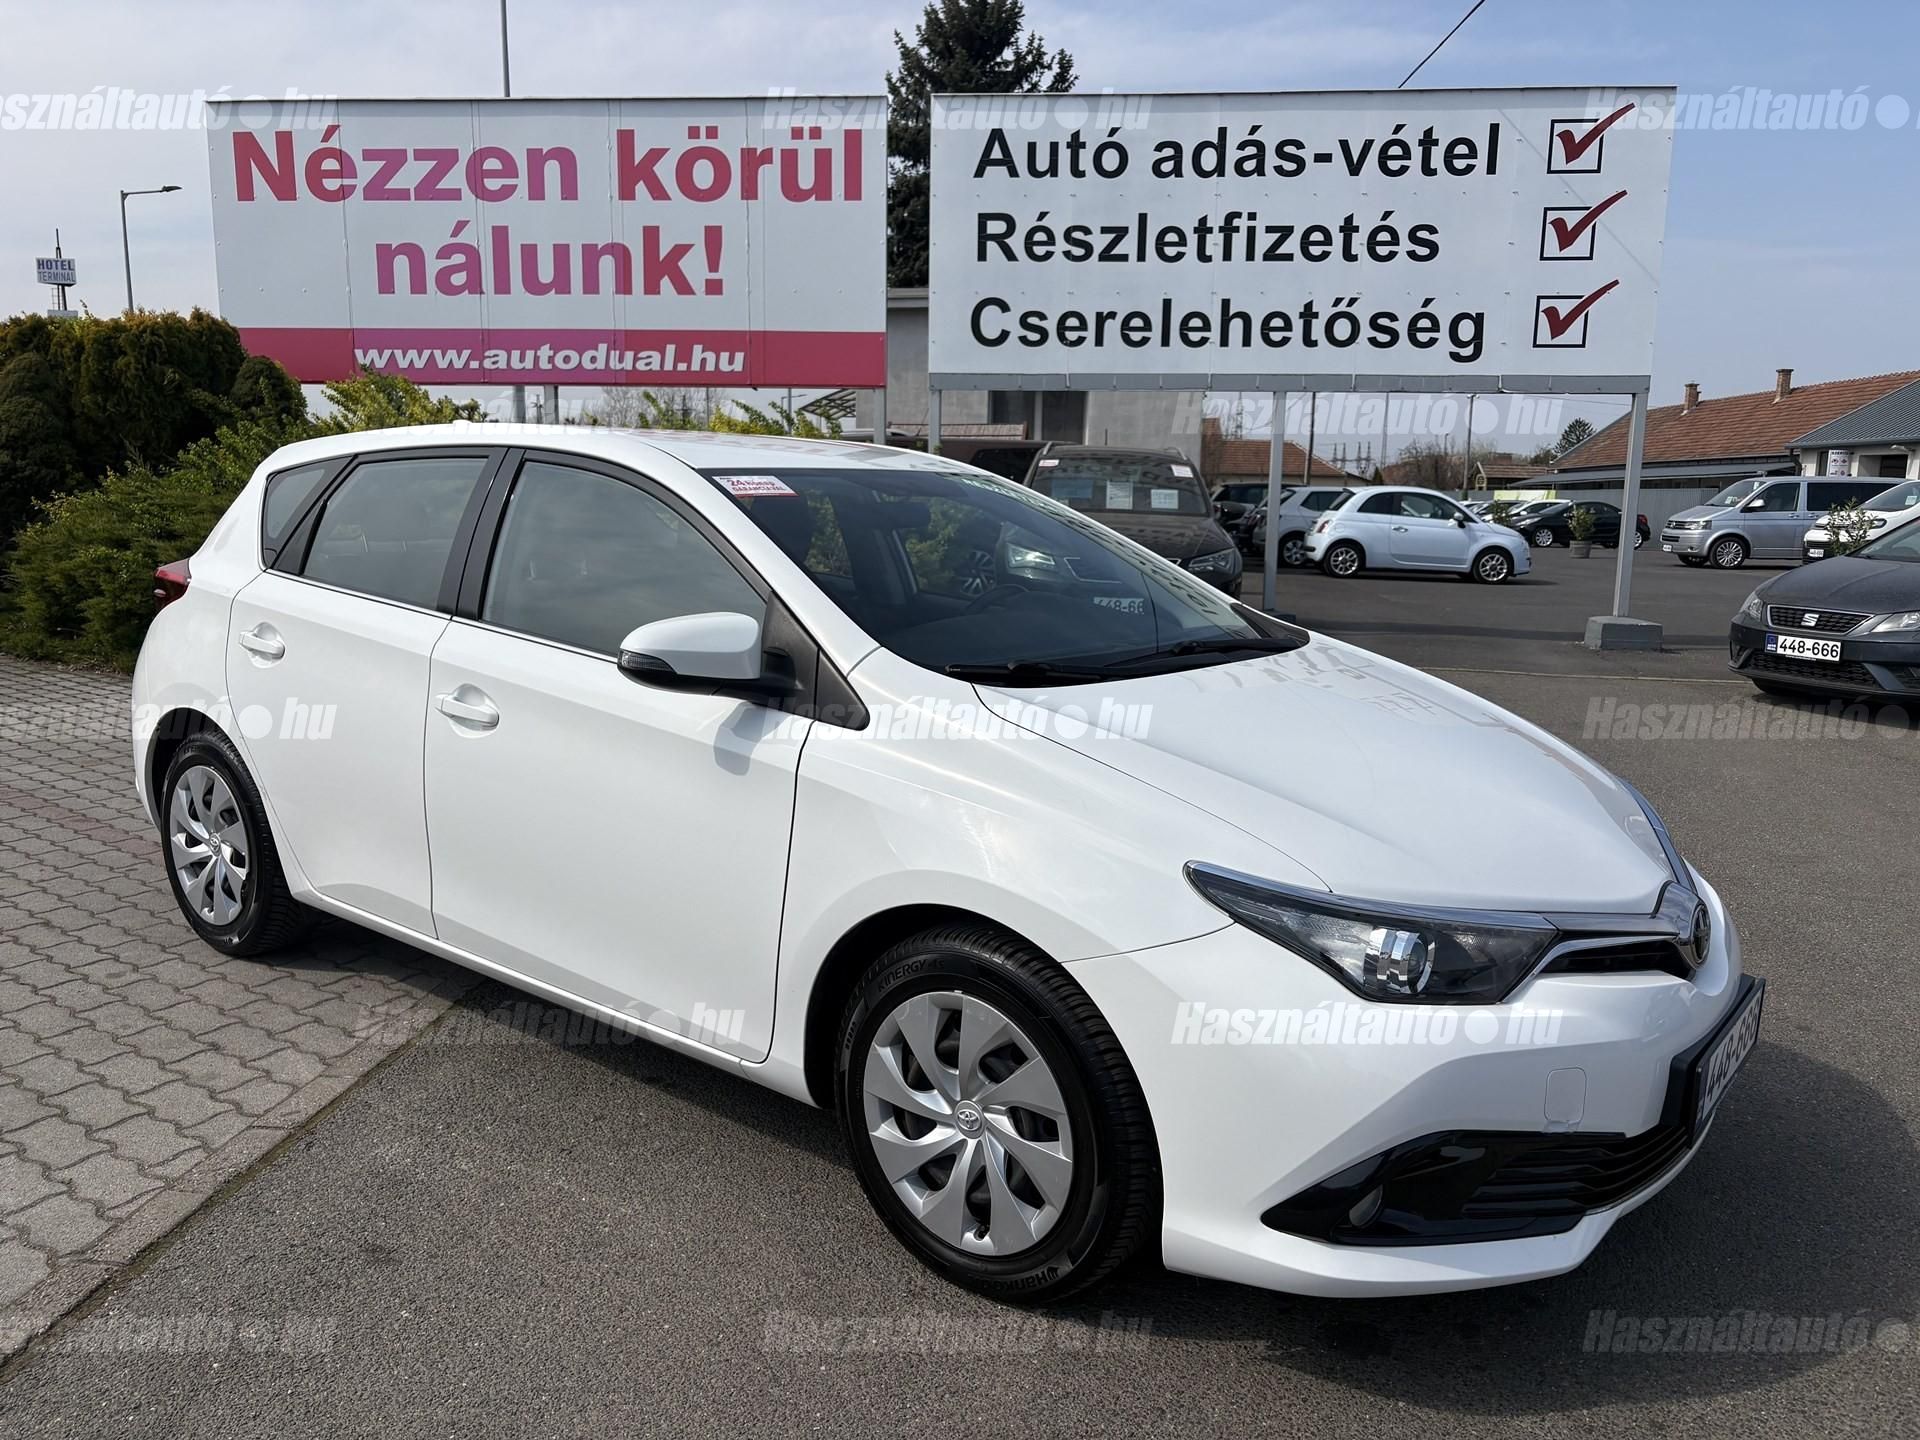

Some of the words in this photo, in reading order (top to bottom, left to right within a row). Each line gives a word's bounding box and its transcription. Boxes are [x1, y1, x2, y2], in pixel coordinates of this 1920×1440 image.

[232, 125, 578, 202] Nézzen
[617, 125, 862, 202] körül
[974, 127, 1129, 179] Autó
[1151, 122, 1500, 180] adás-vétel
[37, 259, 75, 271] HOTEL
[376, 220, 724, 296] nálunk!
[977, 210, 1440, 264] Részletfizetés
[38, 271, 76, 282] TERMINAL
[354, 343, 745, 372] www.autodual.hu
[970, 296, 1485, 364] Cserelehetőség
[1779, 638, 1839, 658] 448-666
[1706, 995, 1760, 1103] 448-666
